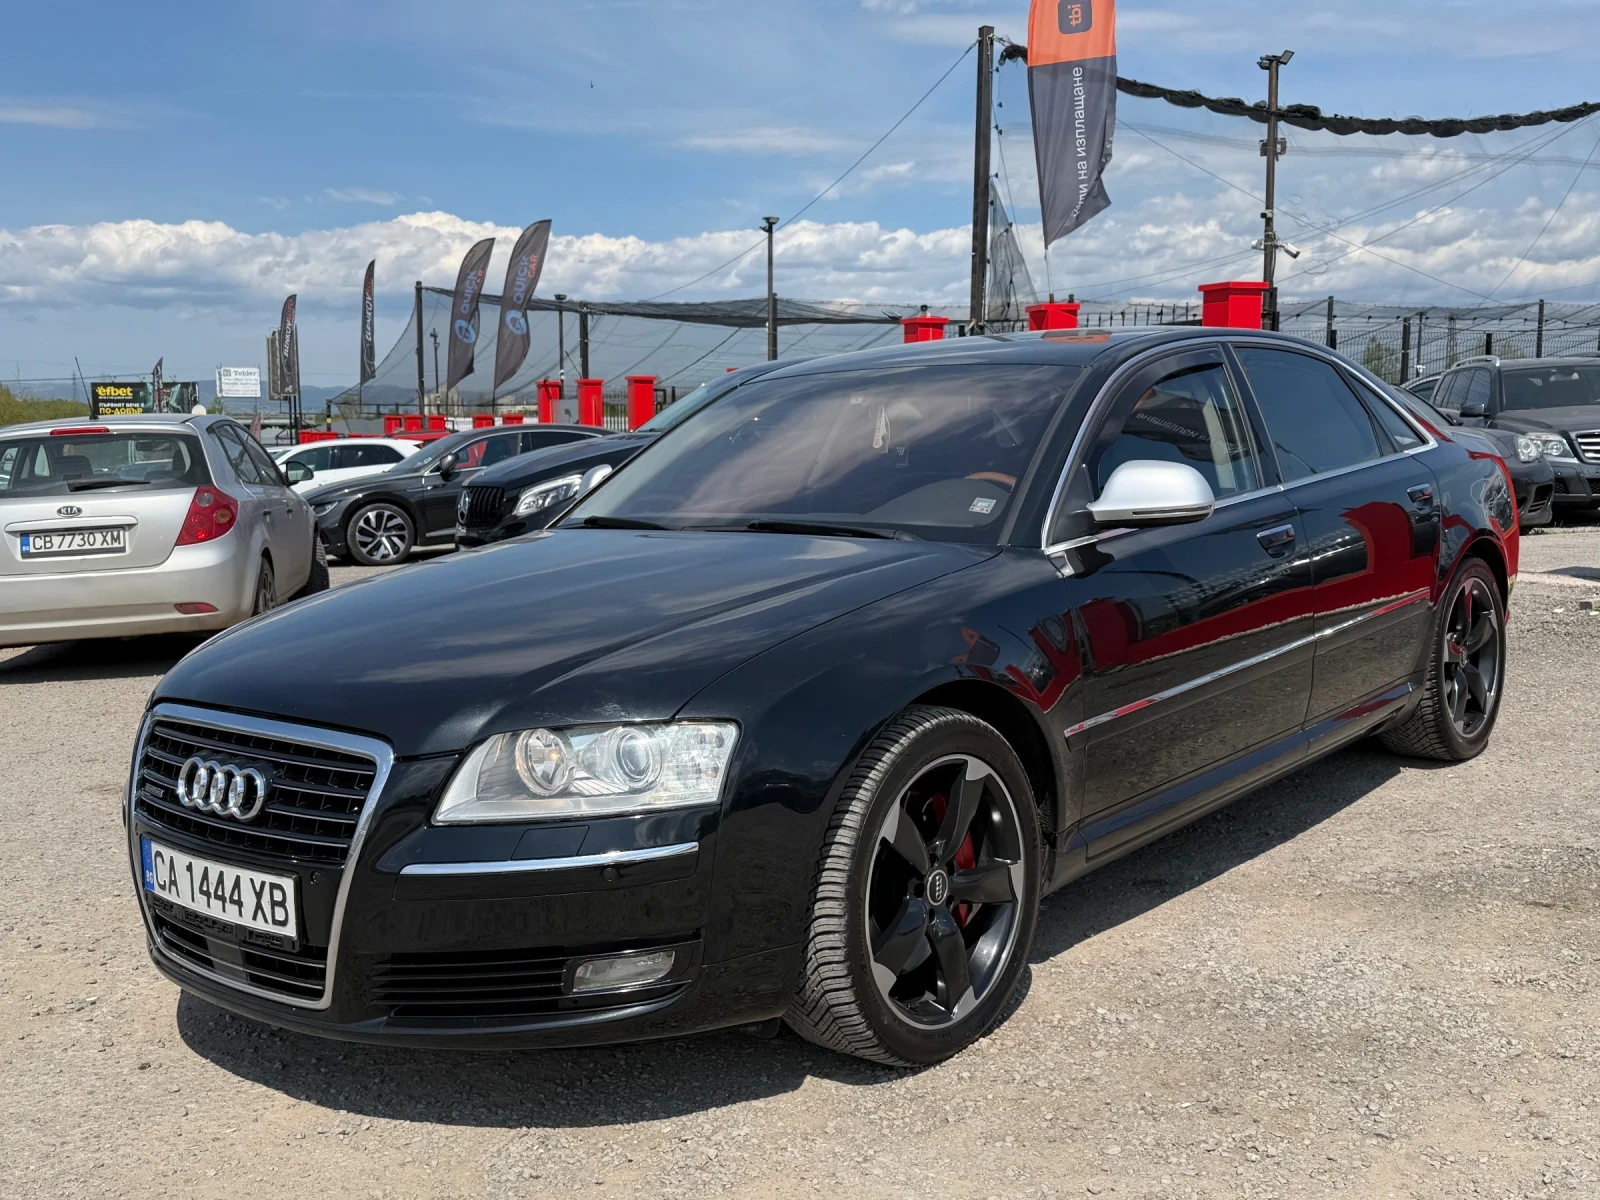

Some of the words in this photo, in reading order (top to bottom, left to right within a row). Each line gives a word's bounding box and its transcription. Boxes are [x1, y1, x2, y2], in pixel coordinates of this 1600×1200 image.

[1069, 3, 1082, 27] tbi
[1073, 66, 1087, 157] изплащане
[1077, 160, 1088, 180] на
[528, 254, 539, 279] CAR
[461, 270, 477, 314] QUICK
[513, 256, 530, 305] QUICK
[97, 386, 133, 396] efbet
[32, 534, 54, 551] CB
[57, 531, 96, 549] 7730
[100, 530, 121, 546] XM
[153, 850, 181, 898] CA
[185, 861, 244, 918] 1444
[248, 877, 290, 927] XB
